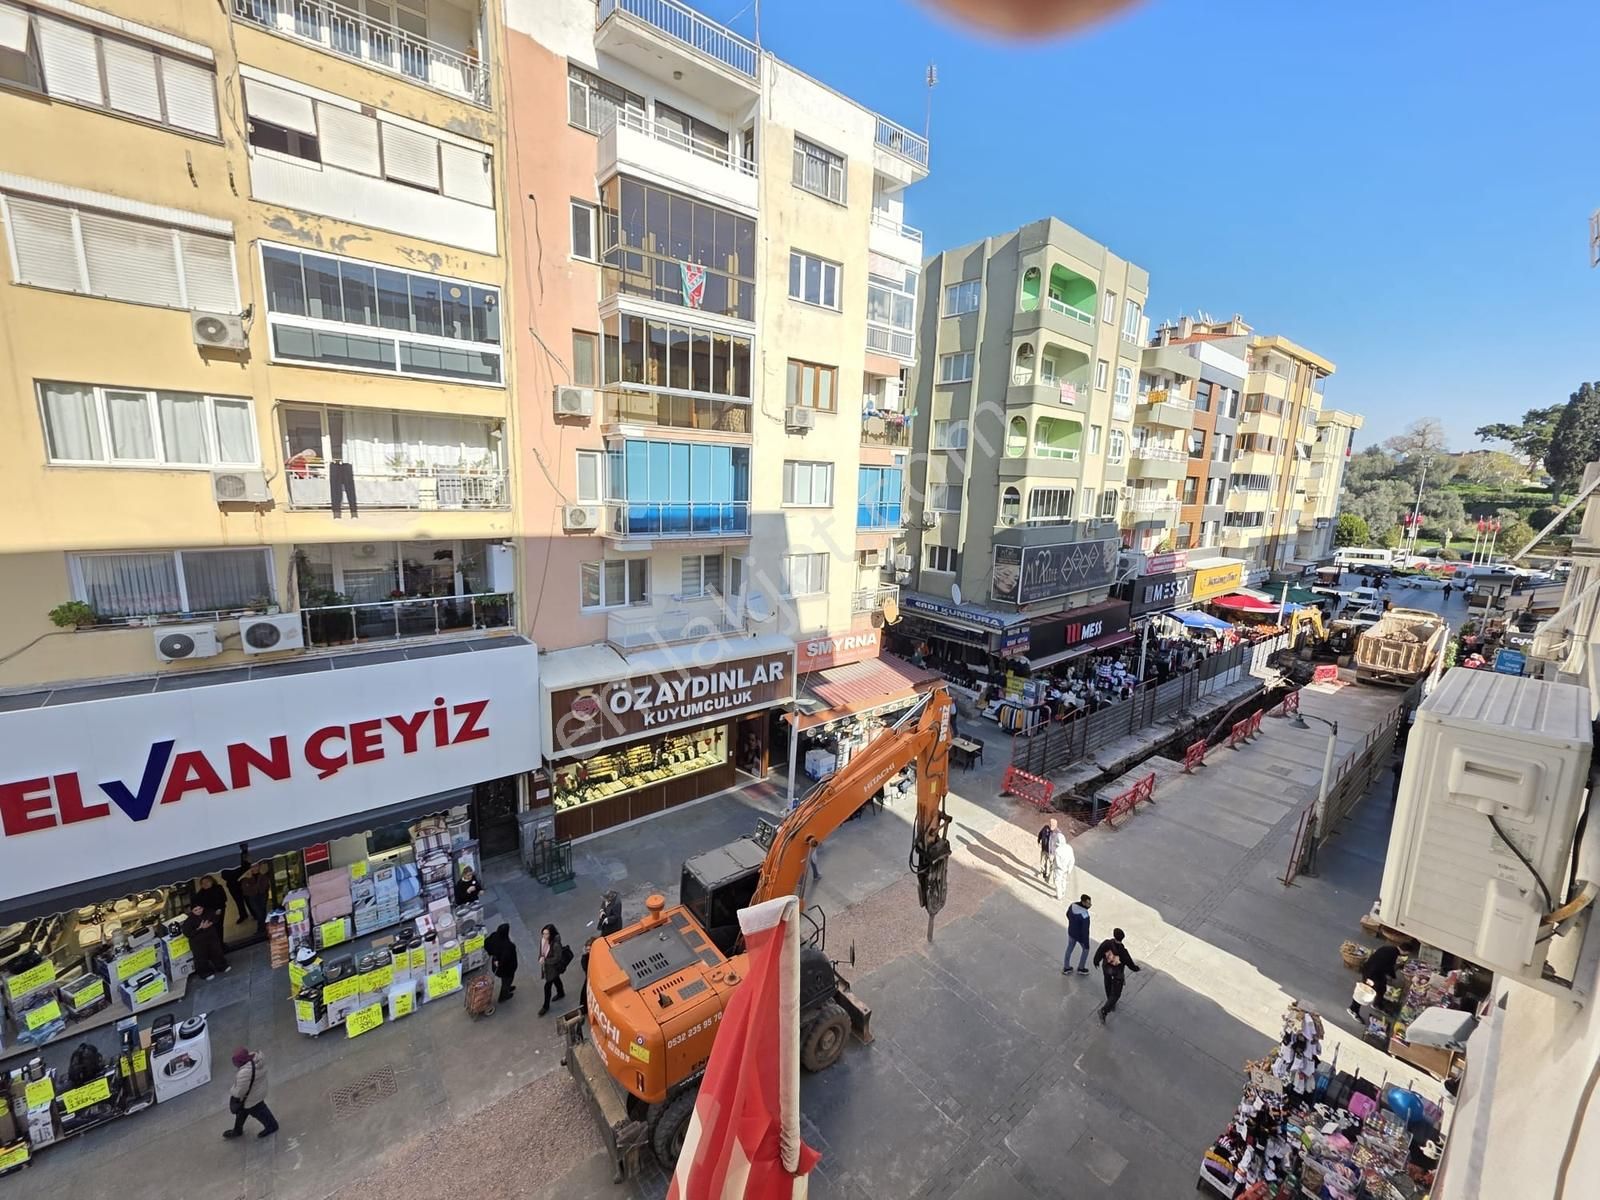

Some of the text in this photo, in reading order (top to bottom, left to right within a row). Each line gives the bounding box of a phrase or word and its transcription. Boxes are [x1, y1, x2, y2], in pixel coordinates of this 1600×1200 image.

[1153, 580, 1188, 601] MESSA
[940, 607, 1001, 626] KUNDURA
[1081, 620, 1103, 640] MESS
[807, 633, 876, 657] SMYRNA
[610, 661, 784, 714] ÖZAYDINLAR
[643, 691, 752, 726] KUYUMCULUK
[0, 697, 490, 836] ELVAN ÇEYİZ
[863, 762, 896, 793] HITACHI
[667, 1034, 687, 1049] 0532
[687, 1024, 702, 1037] 235
[703, 1018, 712, 1029] 95
